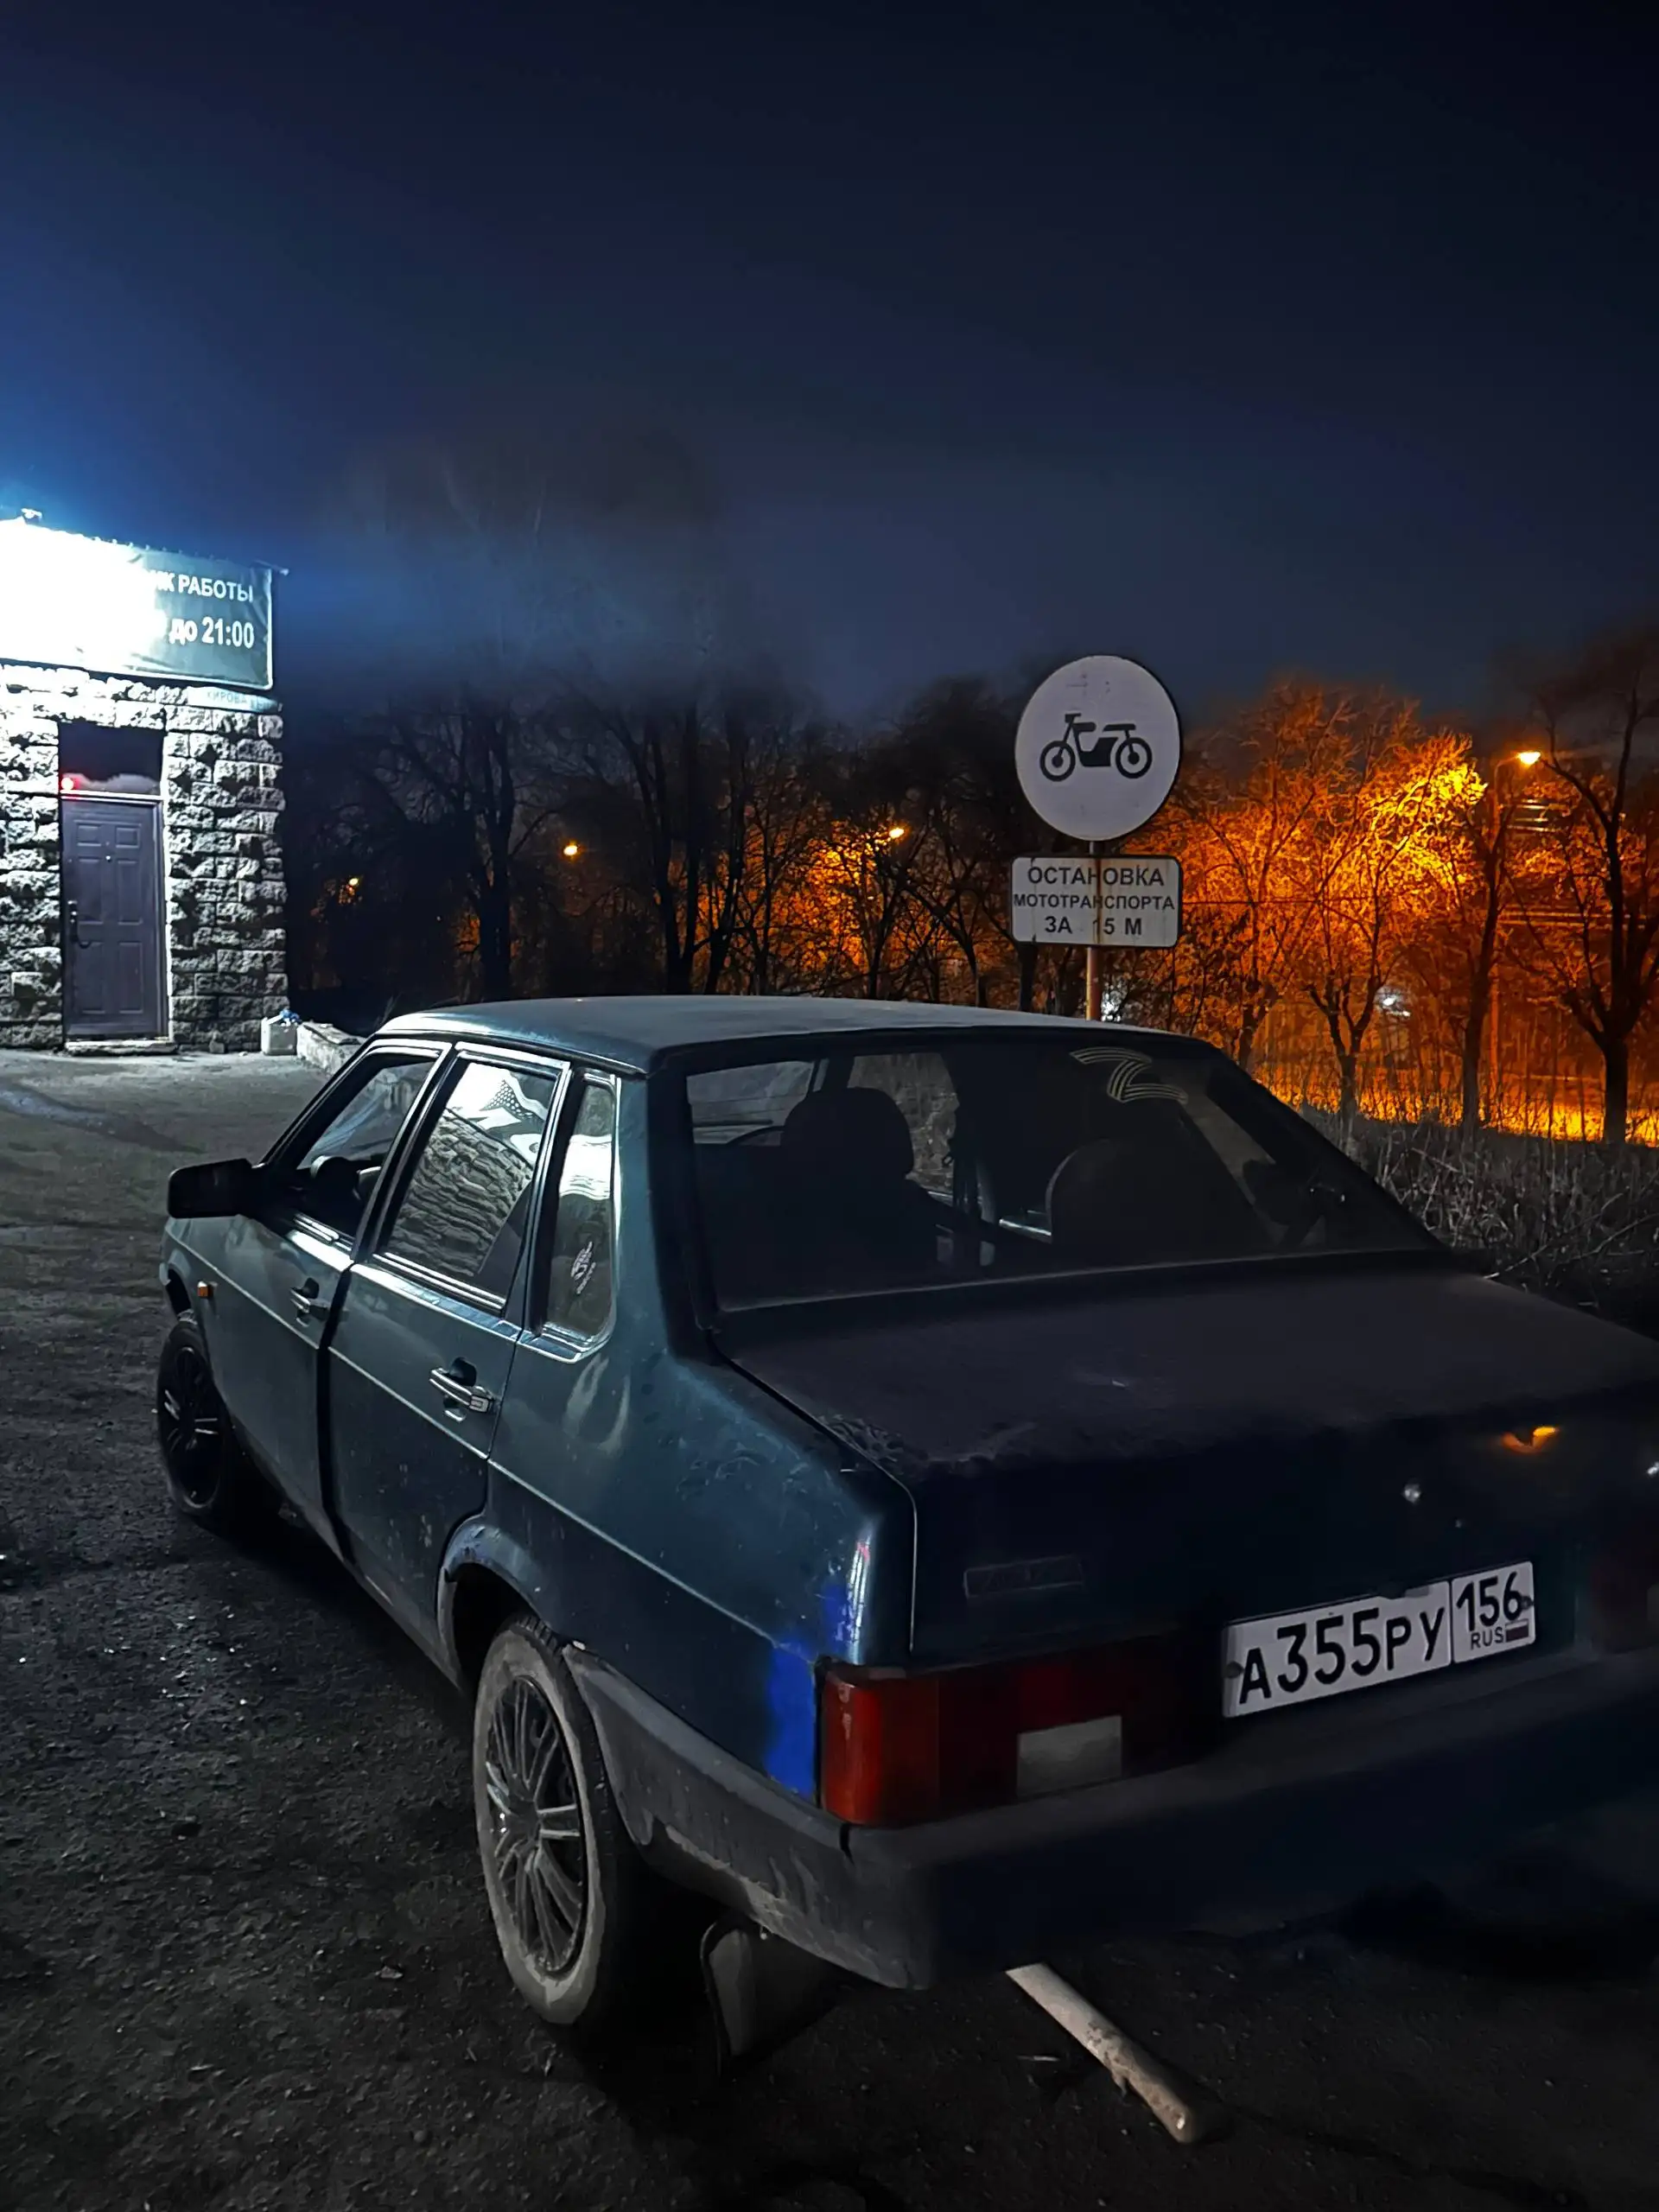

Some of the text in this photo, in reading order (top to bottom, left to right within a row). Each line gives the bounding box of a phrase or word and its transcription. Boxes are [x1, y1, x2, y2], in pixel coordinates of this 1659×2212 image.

[178, 574, 253, 602] РАБОТЫ
[201, 616, 254, 649] 21:00
[1027, 866, 1164, 887] ОСТАНОВКА
[1014, 893, 1175, 910] МОТОТРАНСПОРТА
[1045, 916, 1073, 934] ЗА
[1125, 918, 1142, 936] М
[1456, 1572, 1523, 1631] 156
[1470, 1626, 1505, 1650] RUS
